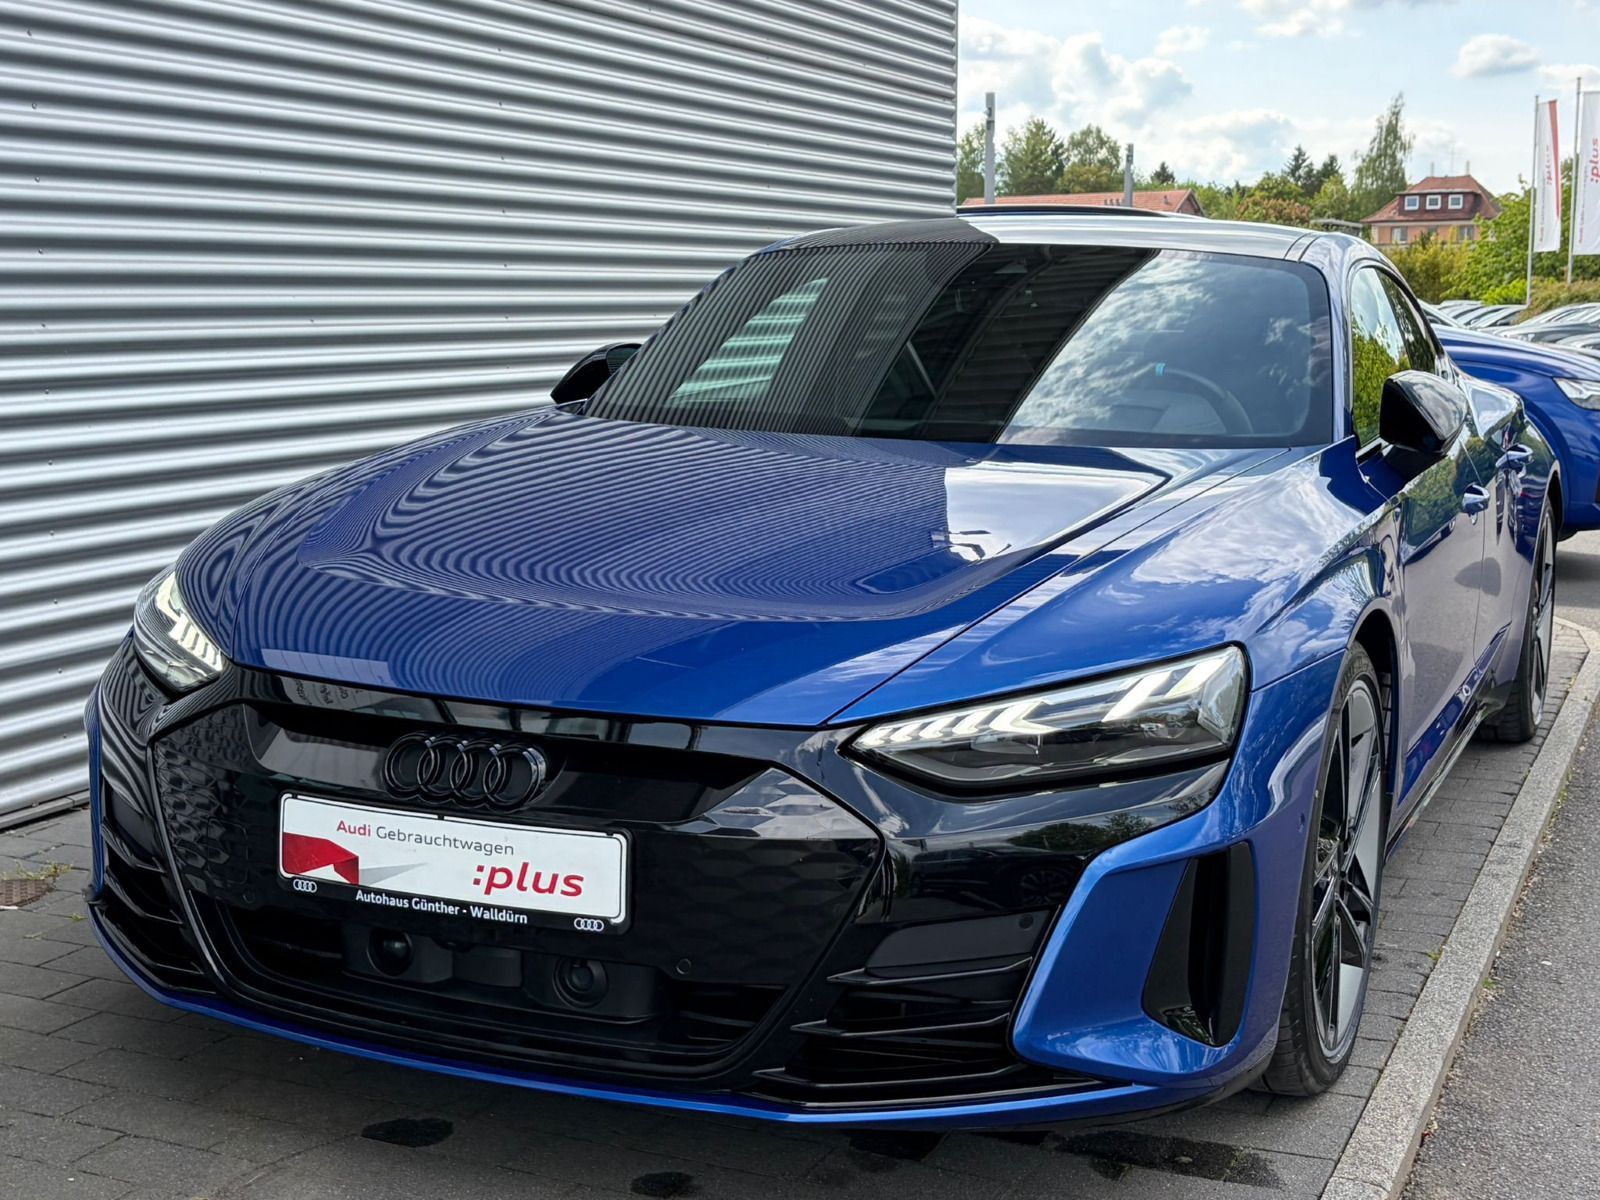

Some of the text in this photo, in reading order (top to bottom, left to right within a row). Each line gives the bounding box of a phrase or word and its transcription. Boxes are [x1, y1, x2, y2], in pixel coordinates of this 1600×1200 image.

[1589, 137, 1600, 183] :plus
[337, 820, 514, 855] Audi Gebrauchtwagen
[473, 862, 584, 896] :plus
[356, 890, 409, 908] Autohaus
[412, 898, 459, 915] Günther
[470, 905, 528, 924] Walldürn
